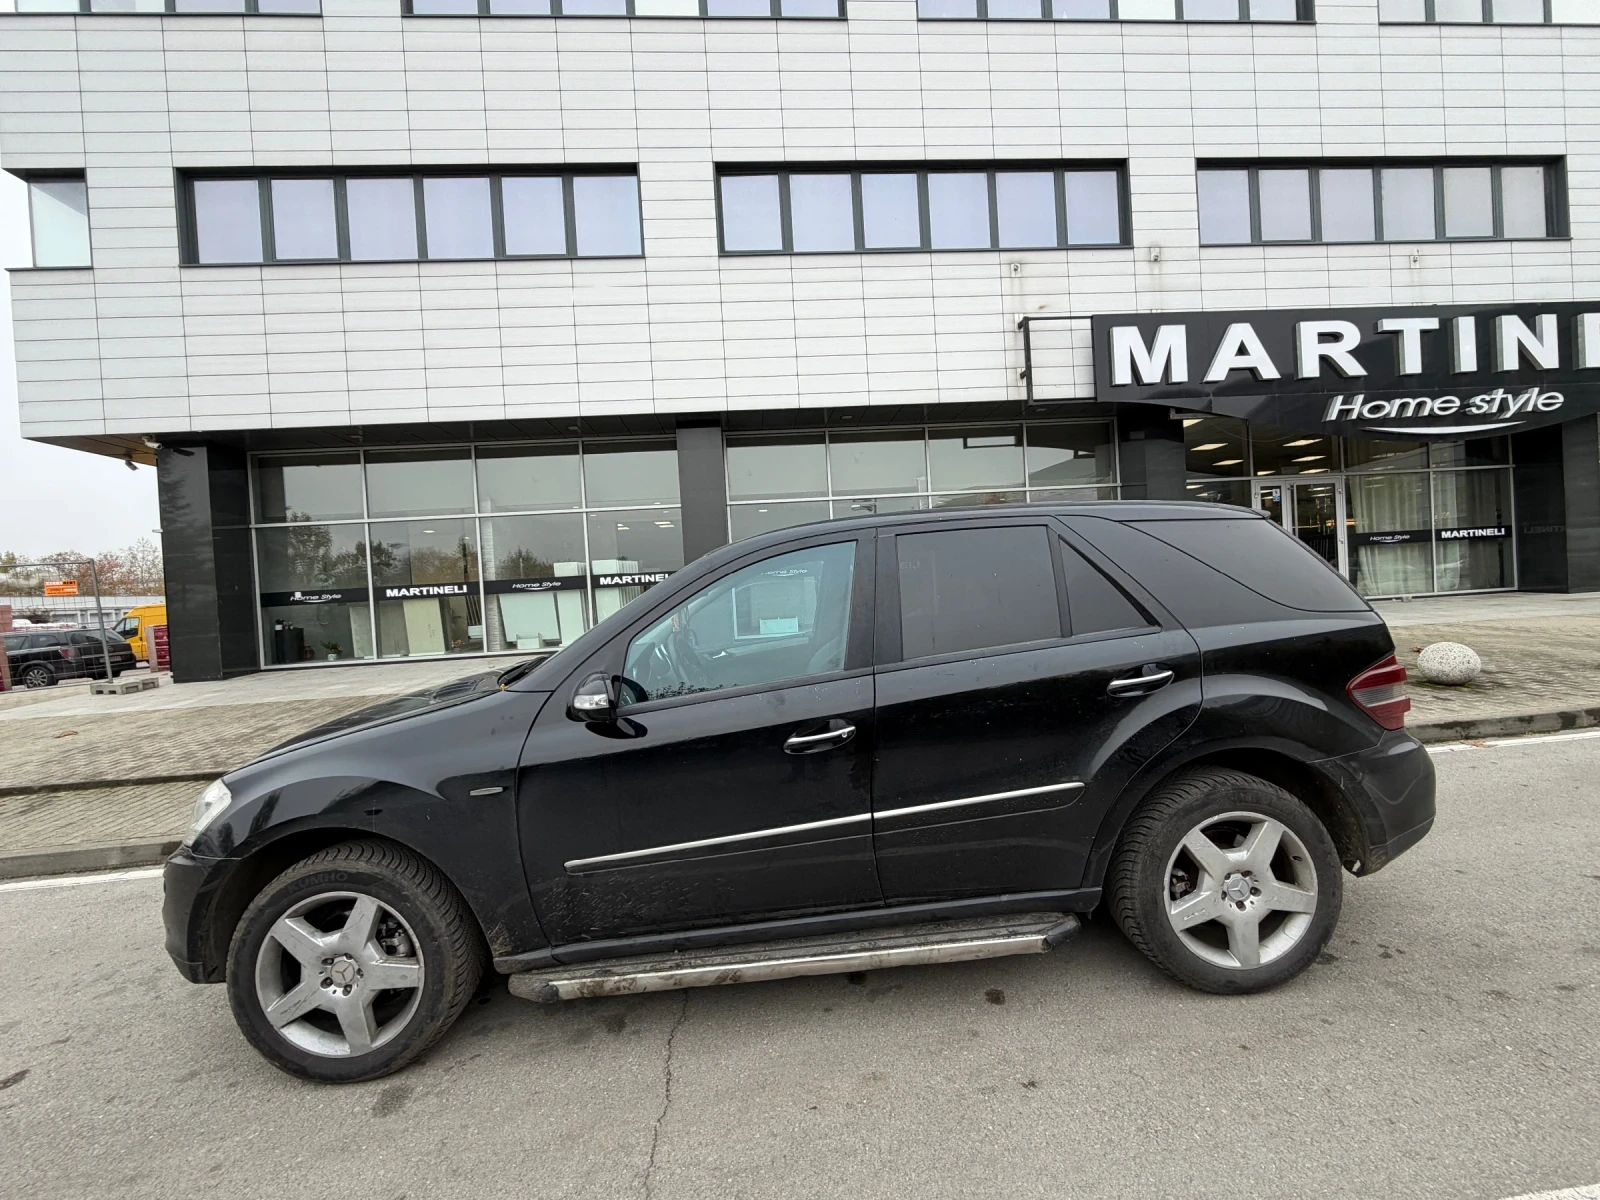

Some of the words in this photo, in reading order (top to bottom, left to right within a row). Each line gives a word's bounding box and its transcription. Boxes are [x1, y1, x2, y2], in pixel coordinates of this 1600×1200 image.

[1323, 394, 1461, 422] Home
[1466, 387, 1565, 420] style
[1441, 527, 1505, 539] MARTINELI
[541, 580, 562, 588] Style
[320, 593, 342, 601] Style
[385, 584, 468, 598] MARTINELI
[287, 871, 349, 895] KUMHO
